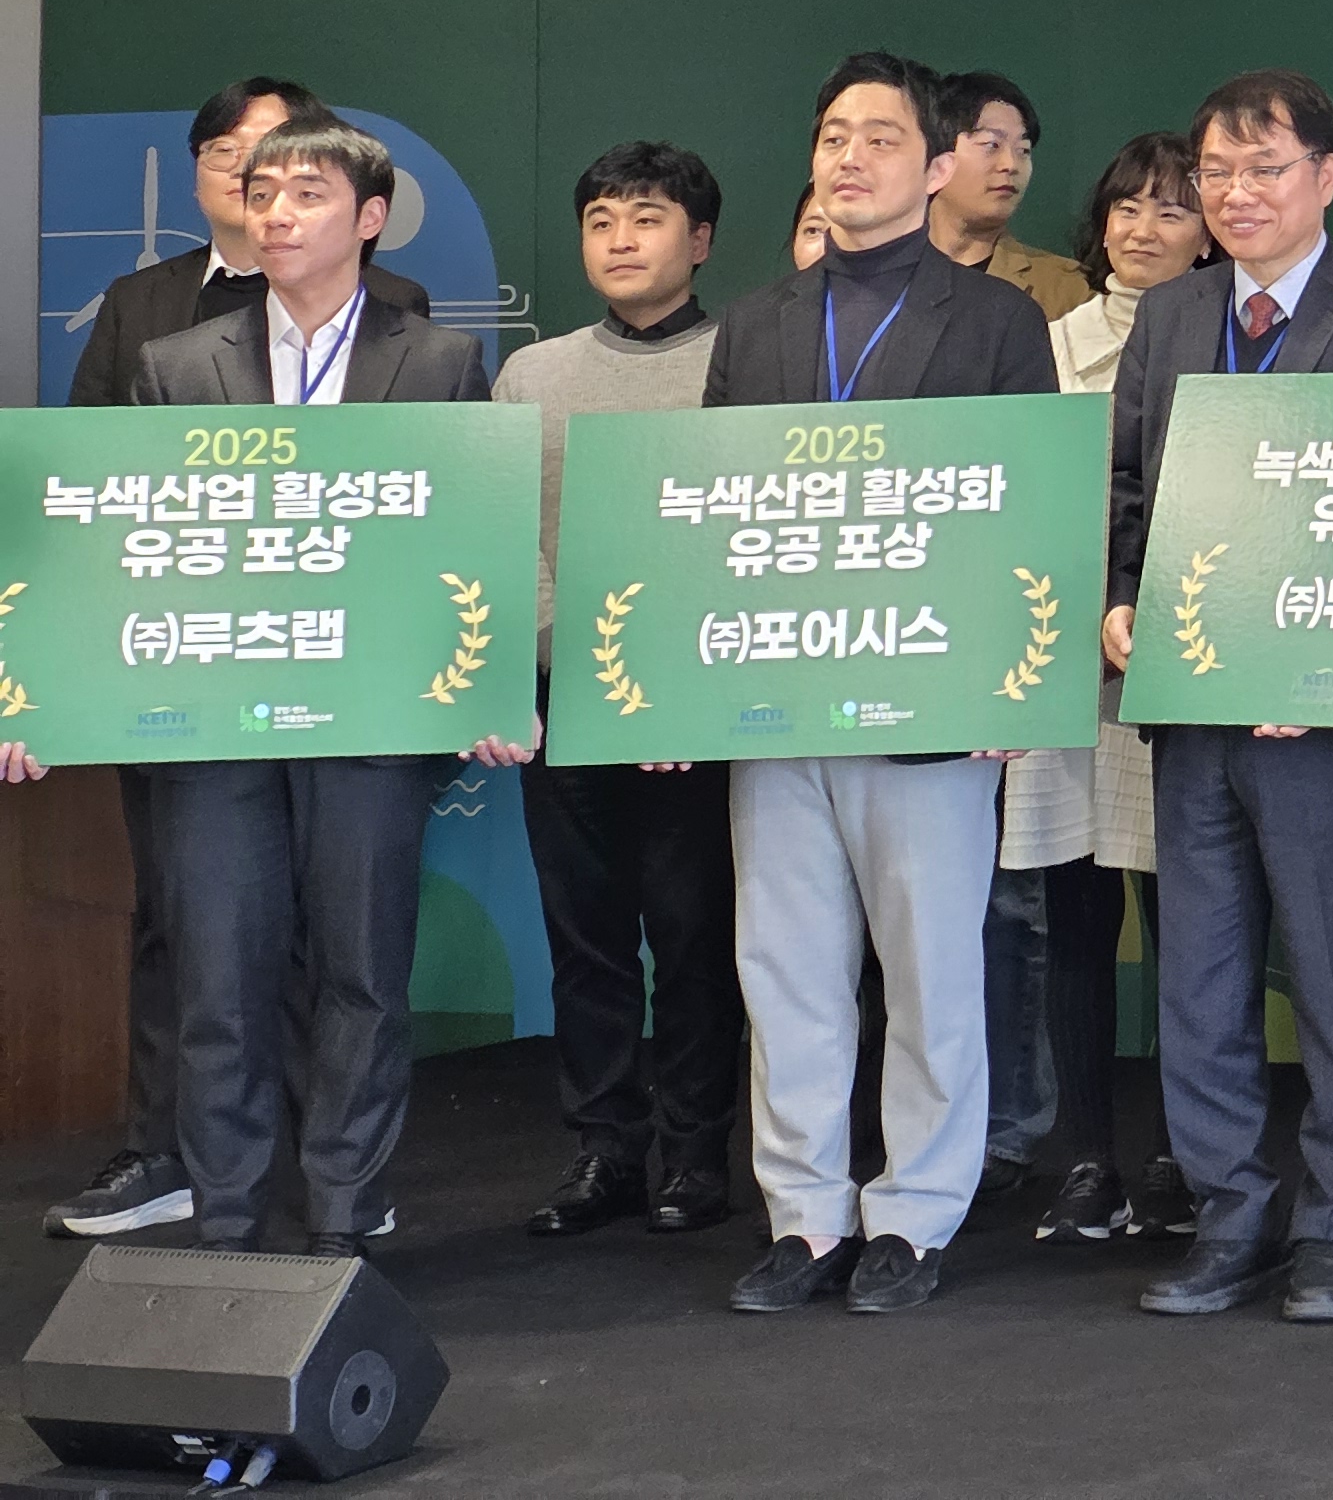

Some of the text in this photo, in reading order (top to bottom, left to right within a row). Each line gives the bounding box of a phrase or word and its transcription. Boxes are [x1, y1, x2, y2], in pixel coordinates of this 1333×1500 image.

[183, 427, 297, 467] 2025
[783, 423, 885, 465] 2025
[43, 470, 433, 524] 녹색산업 활성화
[659, 464, 1007, 525] 녹색산업 활성화
[121, 525, 352, 578] 유공 포상
[726, 521, 933, 577] 유공 포상
